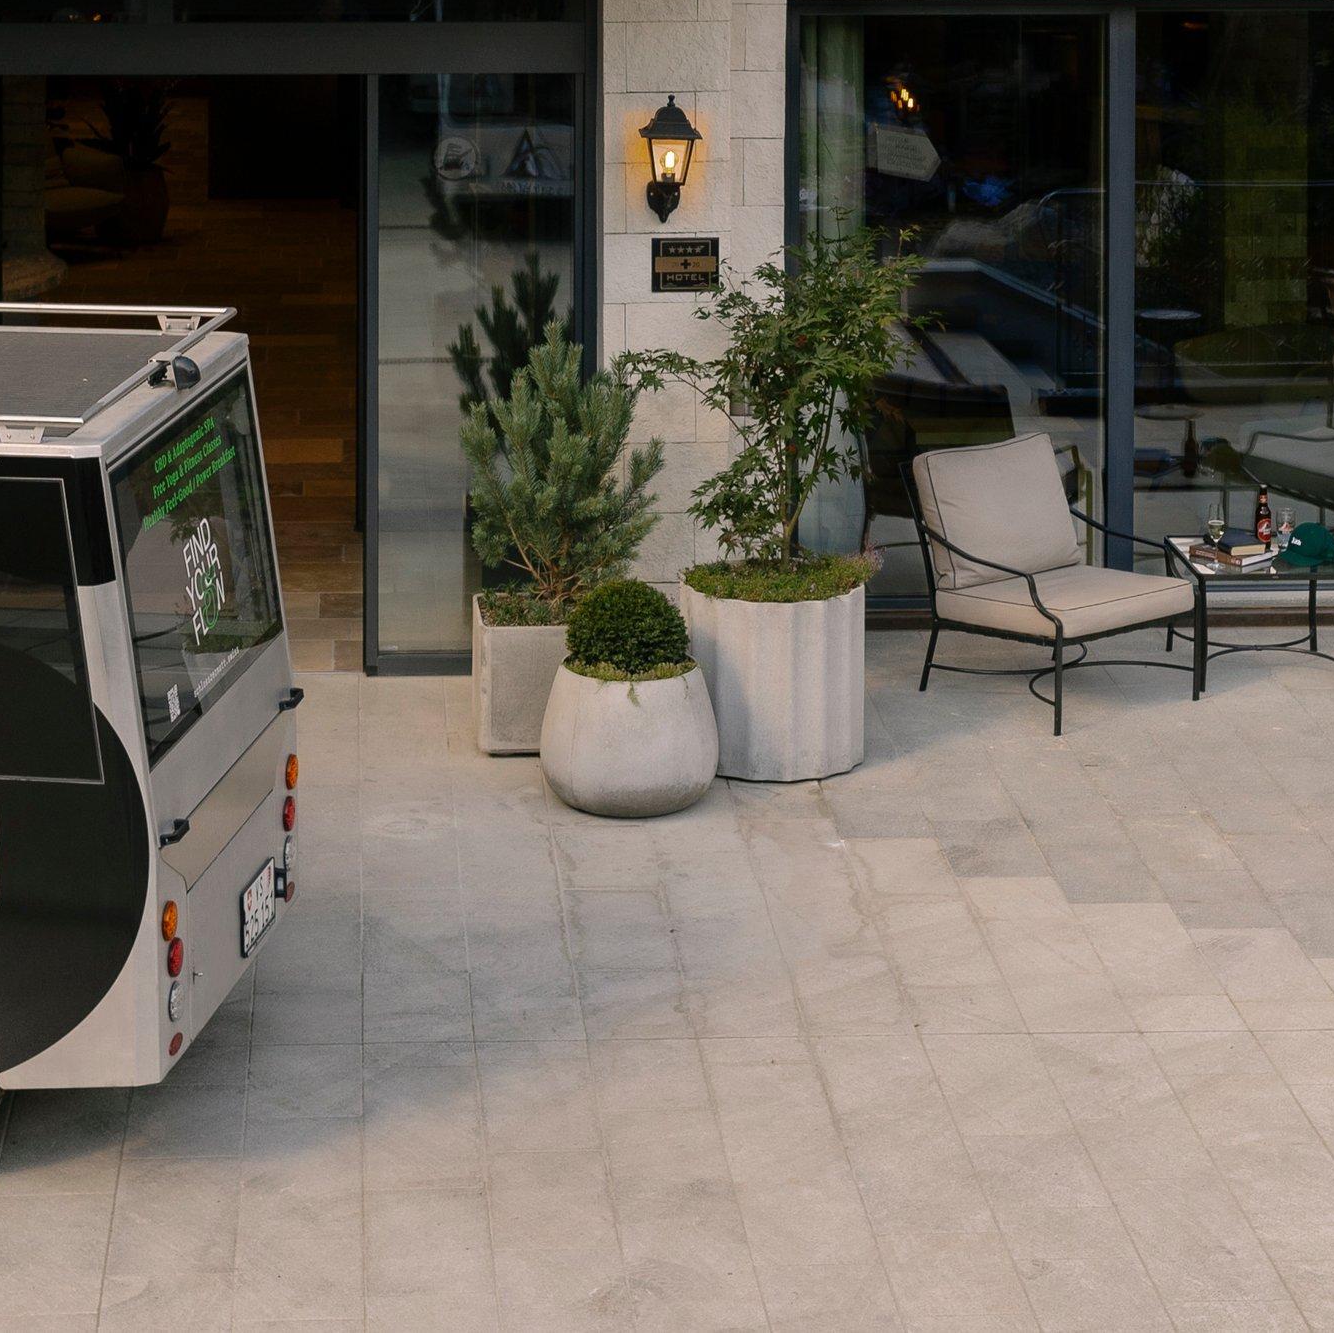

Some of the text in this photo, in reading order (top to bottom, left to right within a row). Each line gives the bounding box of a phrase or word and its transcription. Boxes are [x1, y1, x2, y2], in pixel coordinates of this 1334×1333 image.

[667, 273, 705, 281] HOTEL
[154, 454, 167, 474] CBD
[203, 416, 215, 434] SPA
[152, 481, 166, 500] Free
[165, 471, 179, 489] Yoga
[184, 450, 203, 474] Fitness
[195, 465, 212, 487] Power
[183, 518, 211, 578] FIND
[185, 543, 221, 611] YOUR
